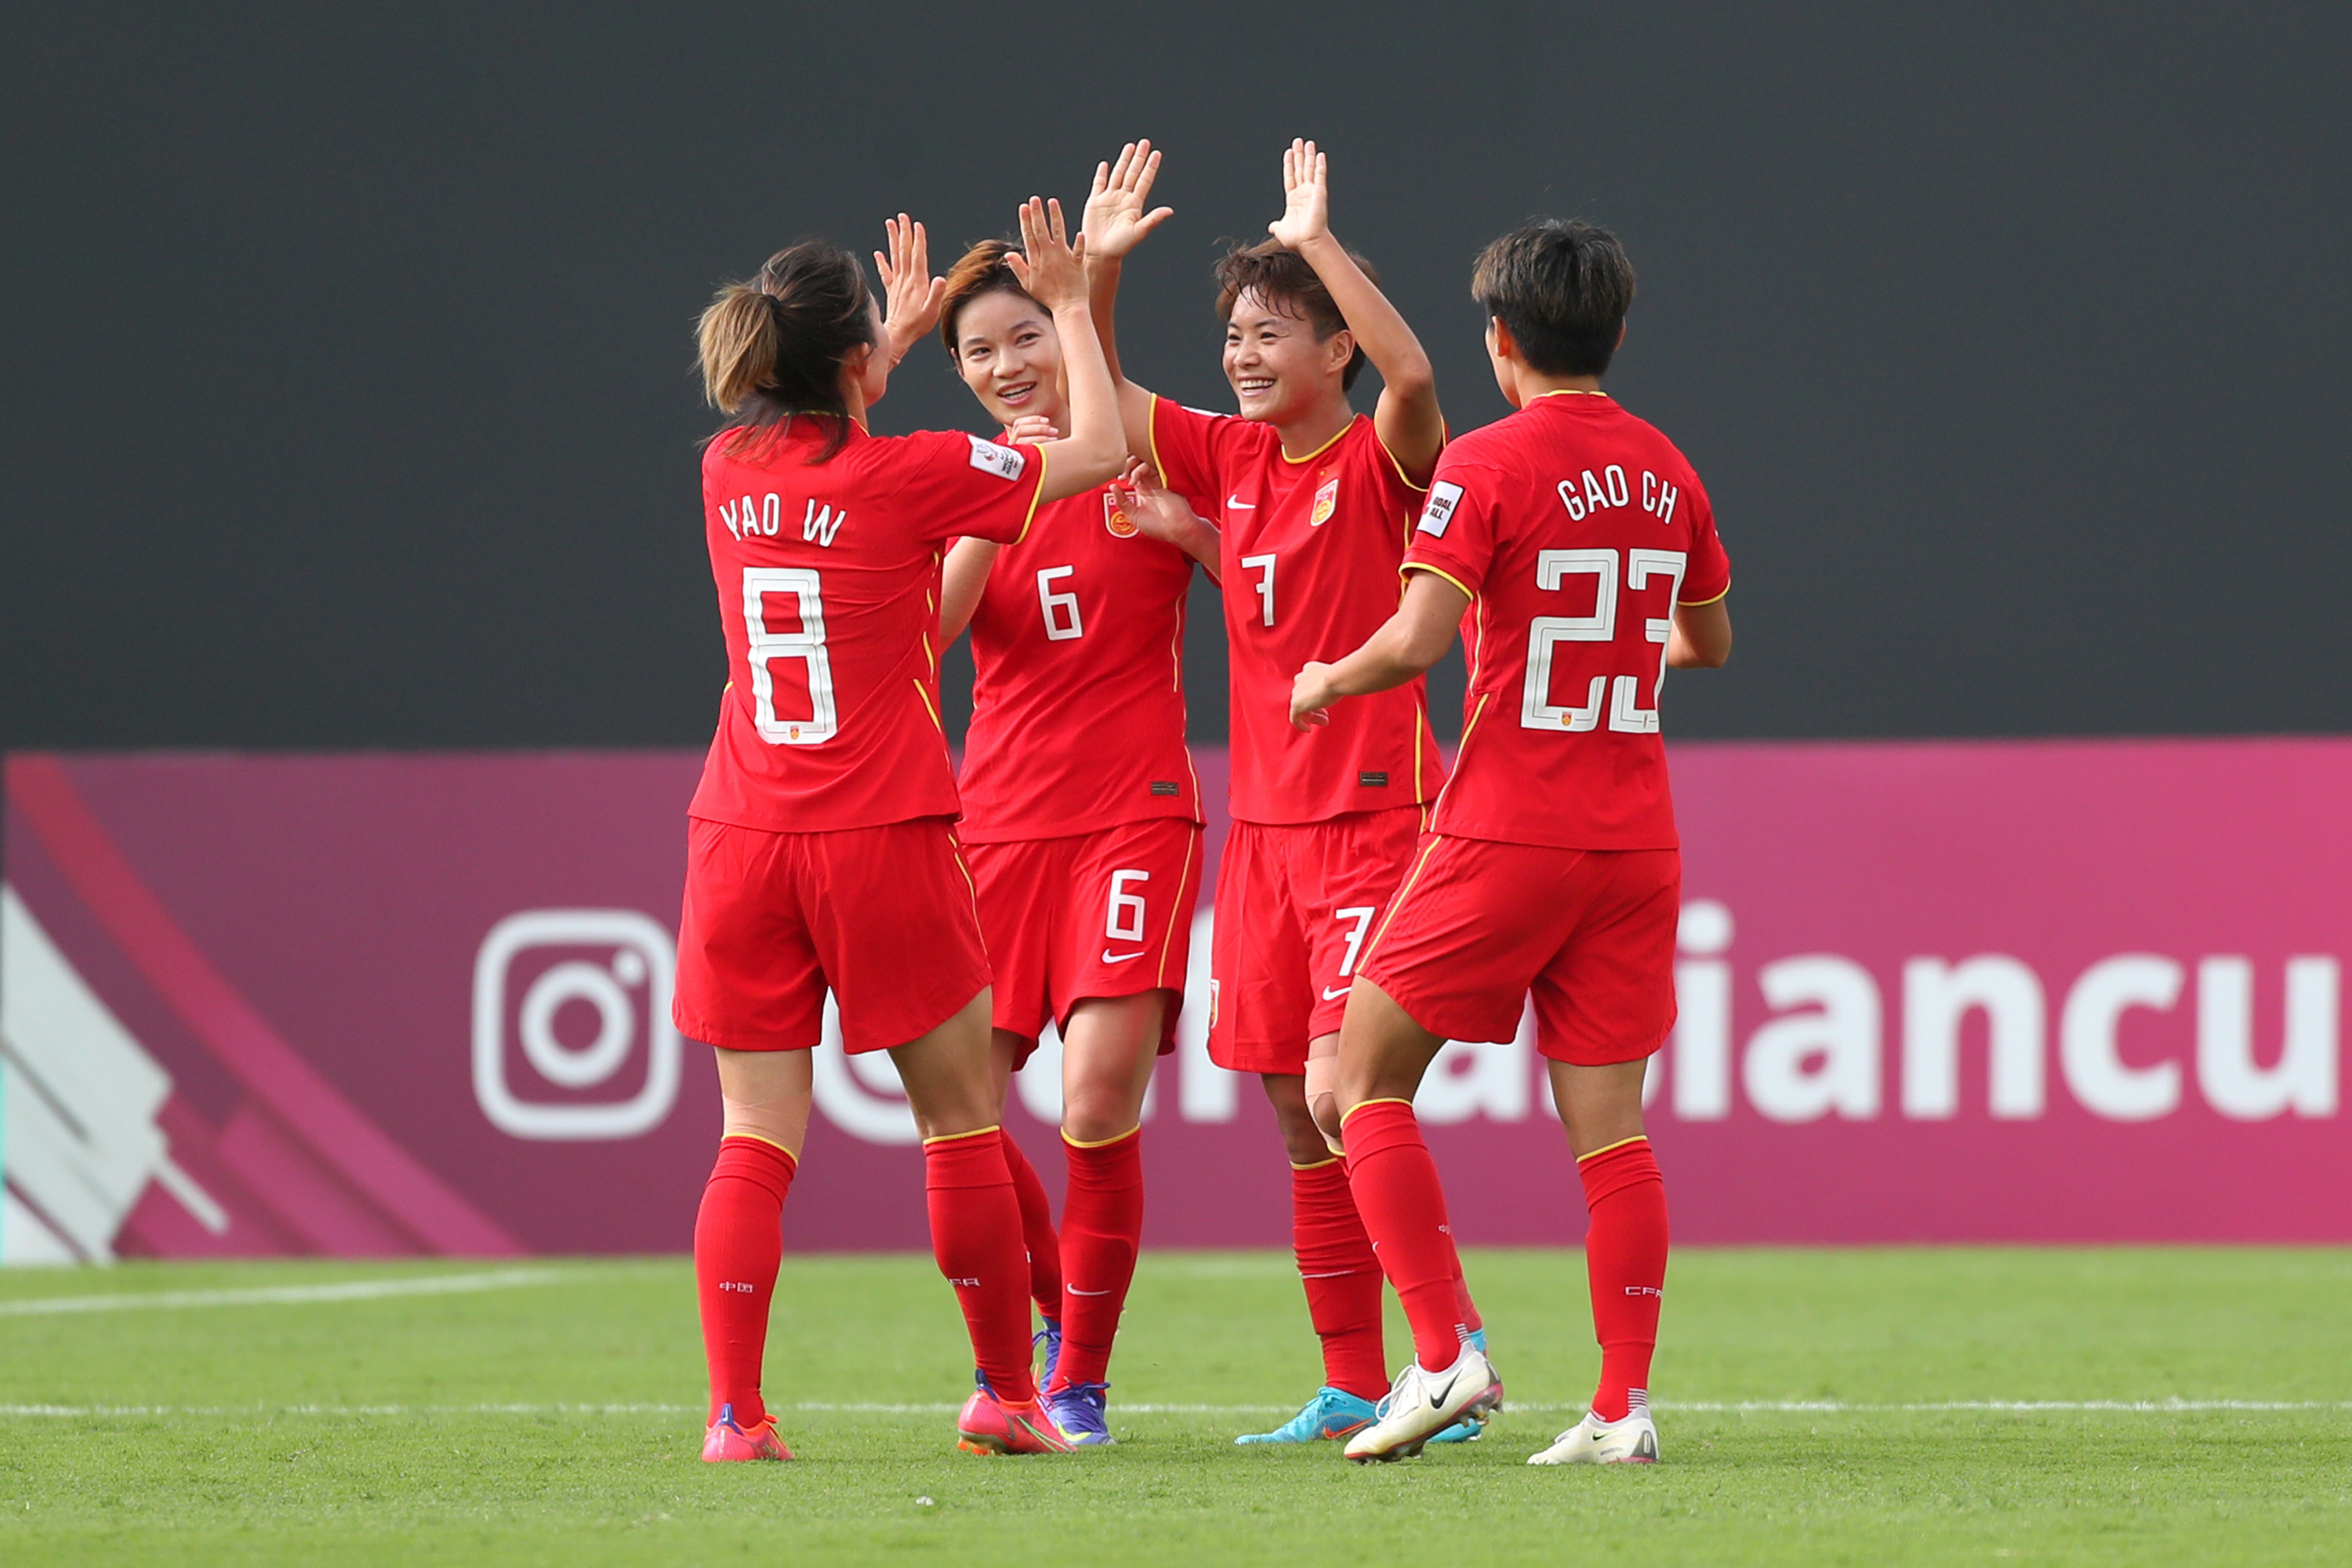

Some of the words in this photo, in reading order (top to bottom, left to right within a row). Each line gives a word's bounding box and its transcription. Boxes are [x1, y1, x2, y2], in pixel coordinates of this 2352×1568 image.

[718, 492, 780, 542] YAO
[802, 499, 847, 547] W
[1429, 507, 1443, 521] ALL
[1432, 496, 1452, 511] GOAL
[1557, 464, 1629, 521] GAO
[1642, 470, 1679, 524] CH
[1036, 564, 1083, 641] 6
[1241, 553, 1276, 626] 7
[742, 567, 838, 746] 8
[1519, 548, 1687, 734] 23
[1105, 869, 1150, 942] 6
[1335, 906, 1376, 978] 7
[719, 1281, 753, 1293] 中国
